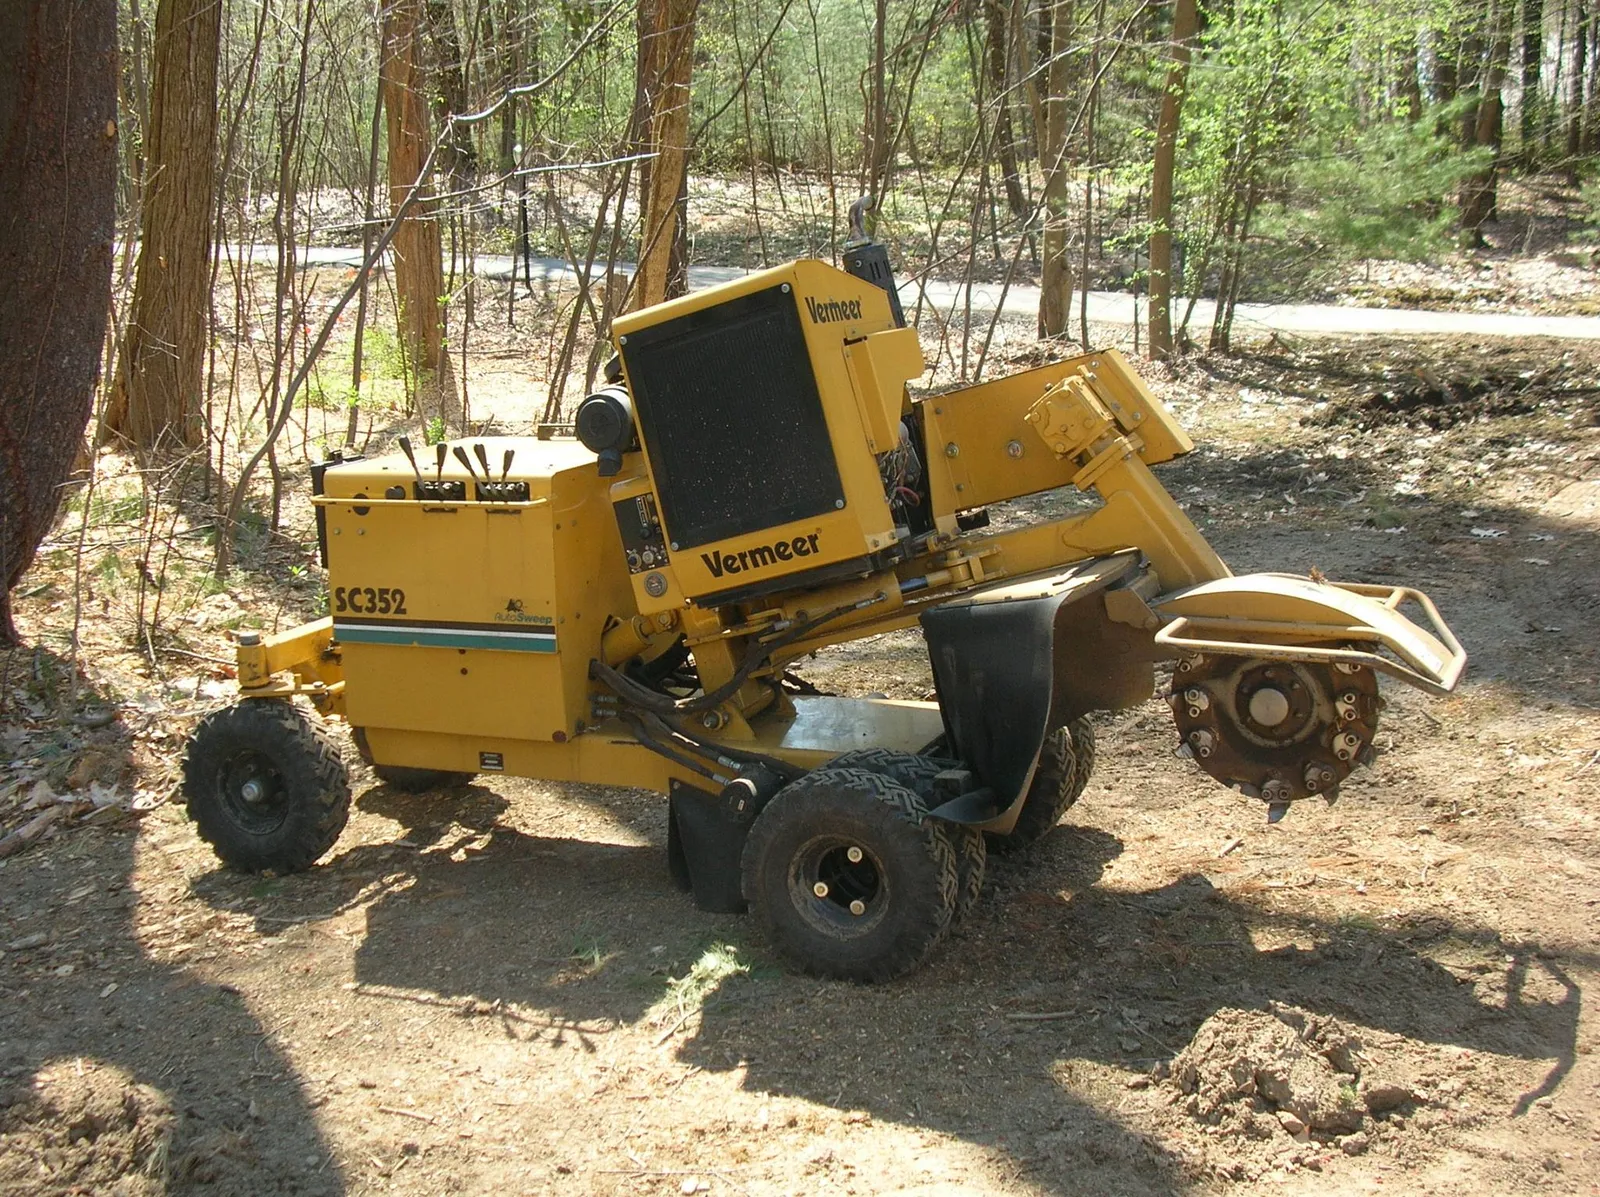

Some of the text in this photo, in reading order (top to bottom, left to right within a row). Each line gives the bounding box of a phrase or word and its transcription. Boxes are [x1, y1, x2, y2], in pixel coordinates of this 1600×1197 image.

[804, 296, 862, 324] Vermeer
[701, 533, 820, 578] Vermeer
[335, 587, 407, 615] SC352
[494, 611, 553, 625] AutoSweep
